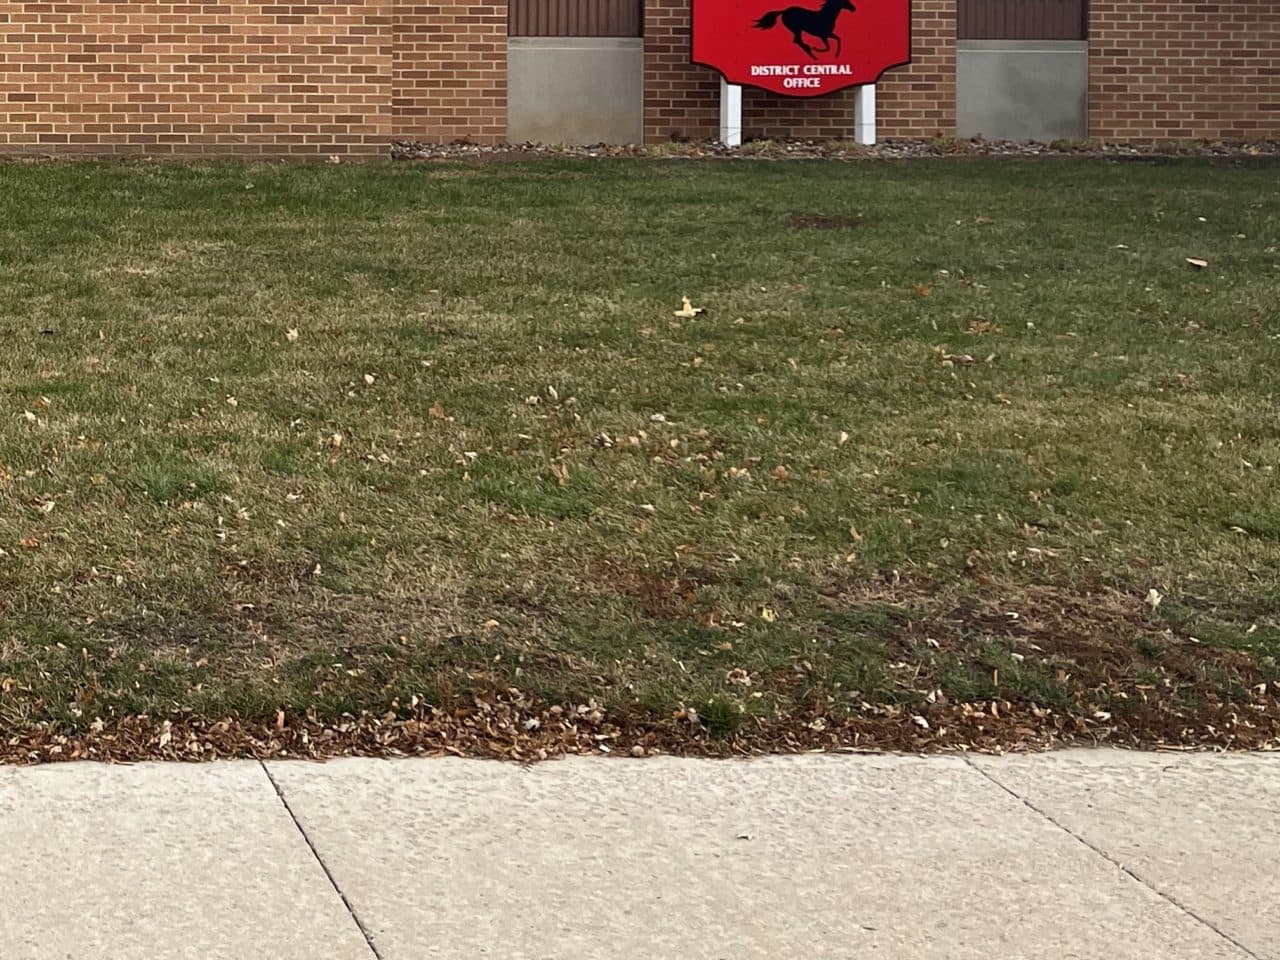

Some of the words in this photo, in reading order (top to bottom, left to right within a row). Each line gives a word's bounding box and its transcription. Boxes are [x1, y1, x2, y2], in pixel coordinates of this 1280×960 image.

[751, 65, 799, 76] DISTRICT
[803, 65, 852, 75] CENTRAL
[783, 77, 820, 88] OFFICE
